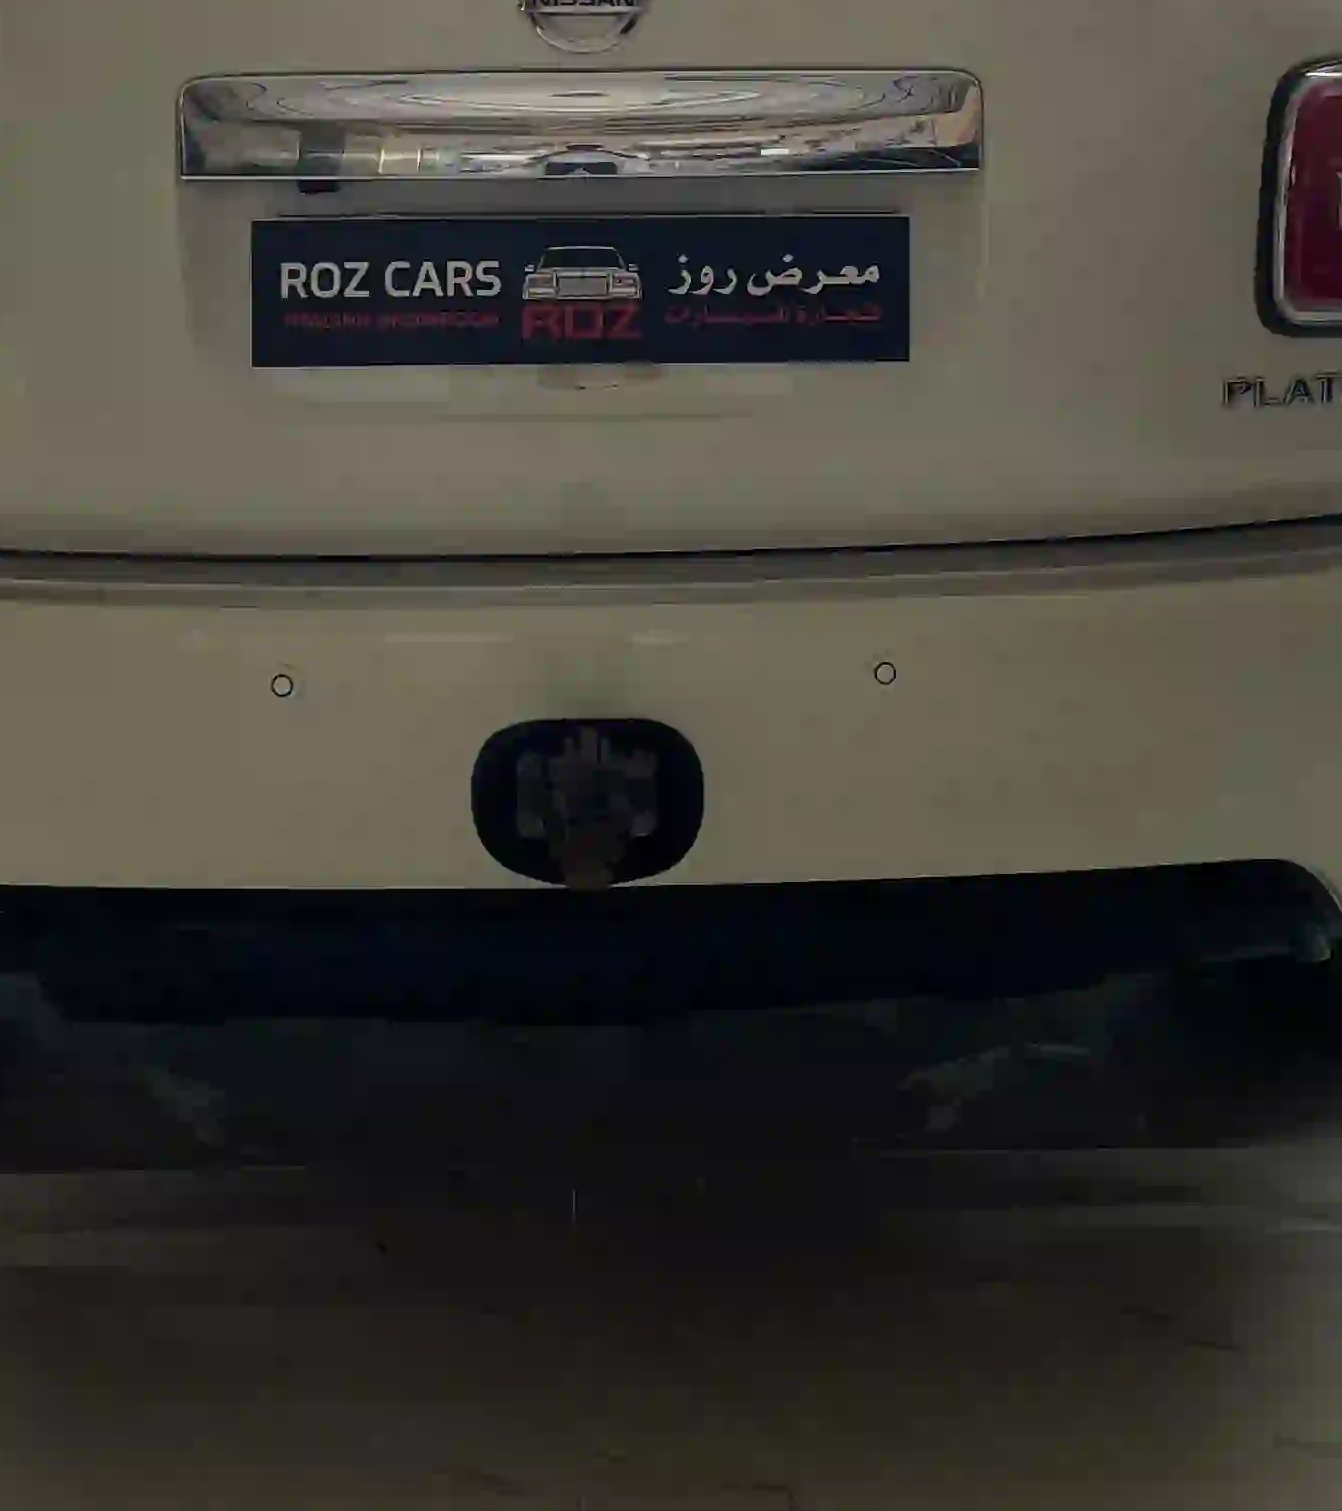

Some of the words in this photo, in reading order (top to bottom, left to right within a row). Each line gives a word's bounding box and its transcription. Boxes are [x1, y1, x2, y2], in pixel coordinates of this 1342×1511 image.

[280, 261, 370, 299] ROZ
[384, 260, 502, 298] CARS
[665, 254, 739, 296] روز
[747, 254, 880, 297] معرض
[522, 305, 642, 339] ROZ
